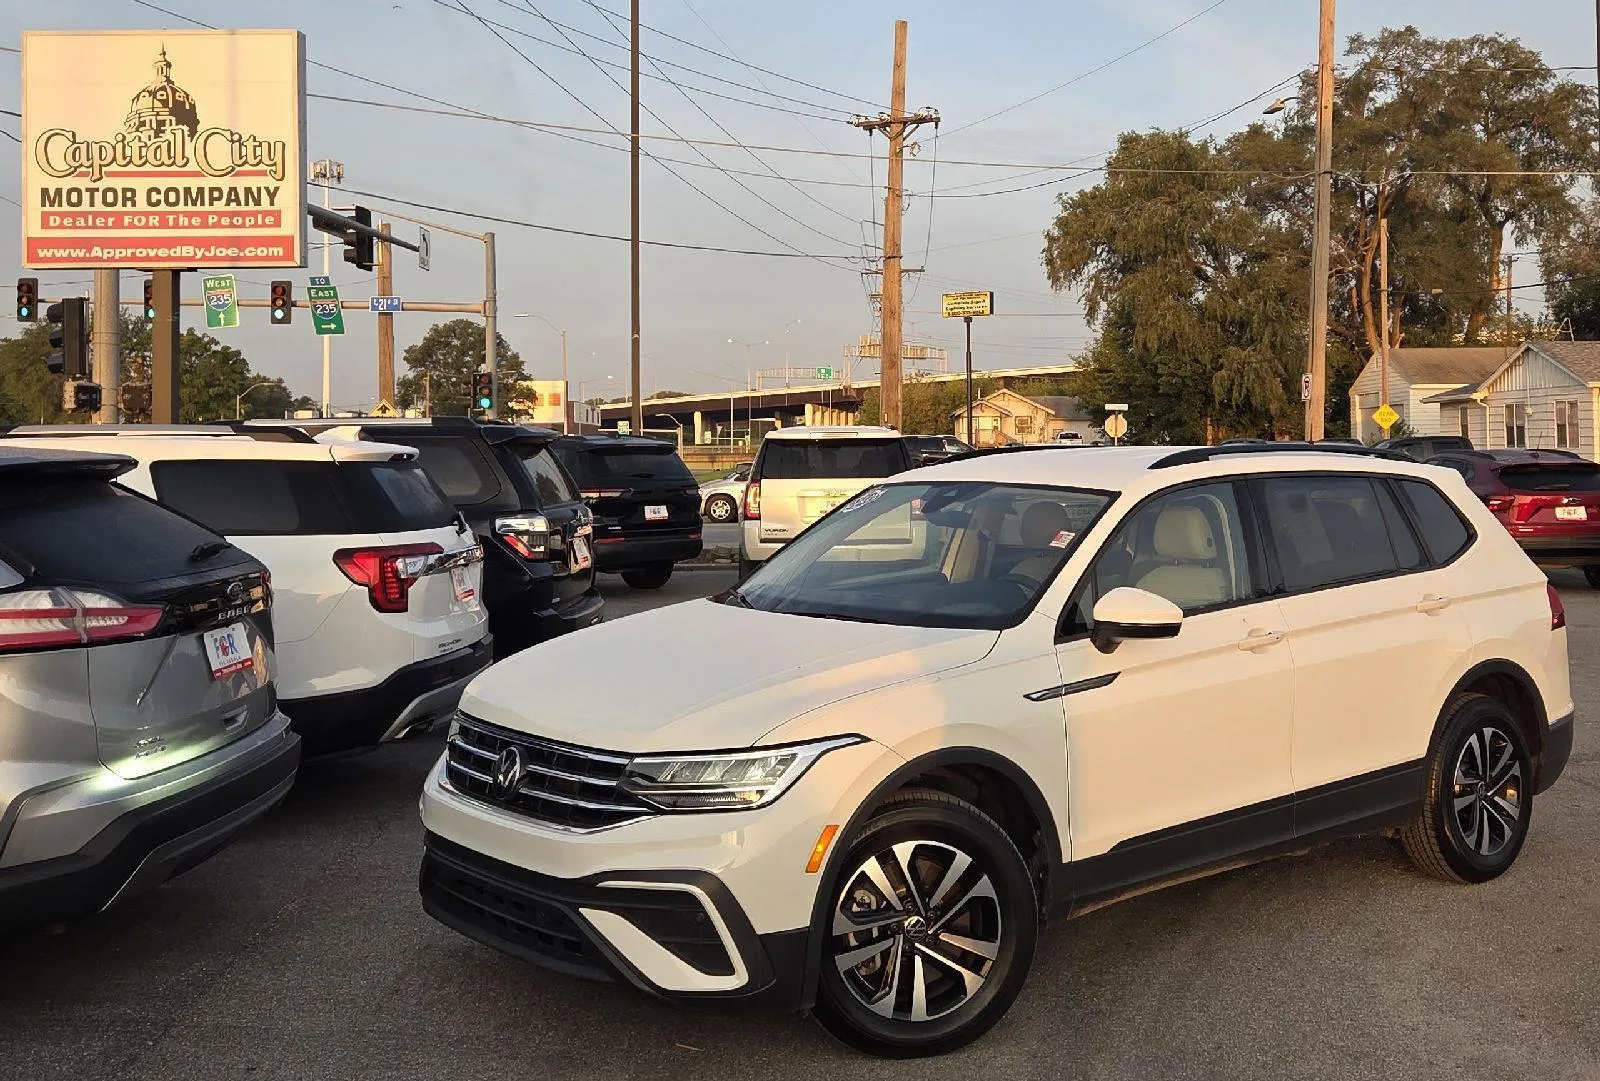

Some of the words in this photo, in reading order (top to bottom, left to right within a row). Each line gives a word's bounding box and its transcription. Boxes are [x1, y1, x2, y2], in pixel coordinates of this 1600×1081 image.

[35, 127, 190, 182] Capital
[194, 127, 286, 182] City
[40, 187, 138, 208] MOTOR
[146, 186, 281, 207] COMPANY
[49, 214, 116, 228] Dealer
[123, 215, 160, 228] FOR
[166, 214, 202, 227] The
[207, 214, 276, 228] People
[37, 244, 284, 260] www.ApprovedByJoe.com
[205, 279, 232, 289] WEST
[315, 277, 326, 285] TO
[310, 289, 335, 298] EAST
[210, 295, 232, 305] 235
[316, 304, 337, 314] 235
